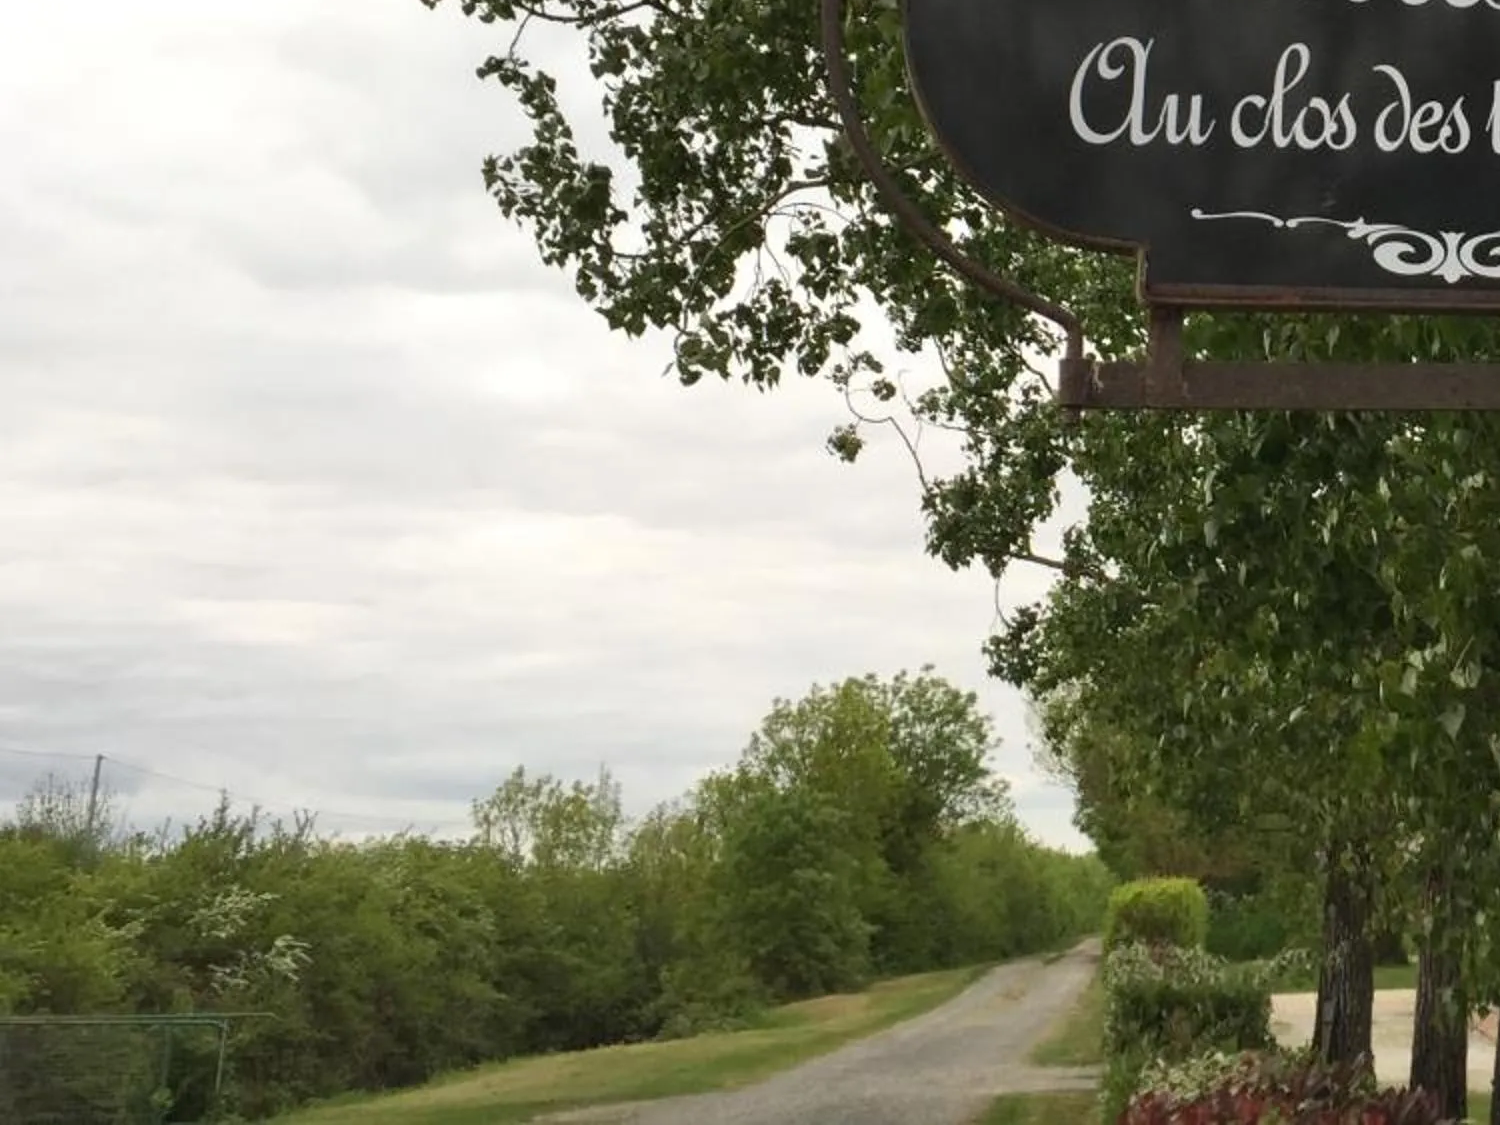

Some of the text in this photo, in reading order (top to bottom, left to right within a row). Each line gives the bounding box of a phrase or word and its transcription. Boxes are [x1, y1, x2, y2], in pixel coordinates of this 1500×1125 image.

[1068, 36, 1216, 146] Au
[1230, 42, 1358, 152] clos
[1372, 64, 1472, 154] des
